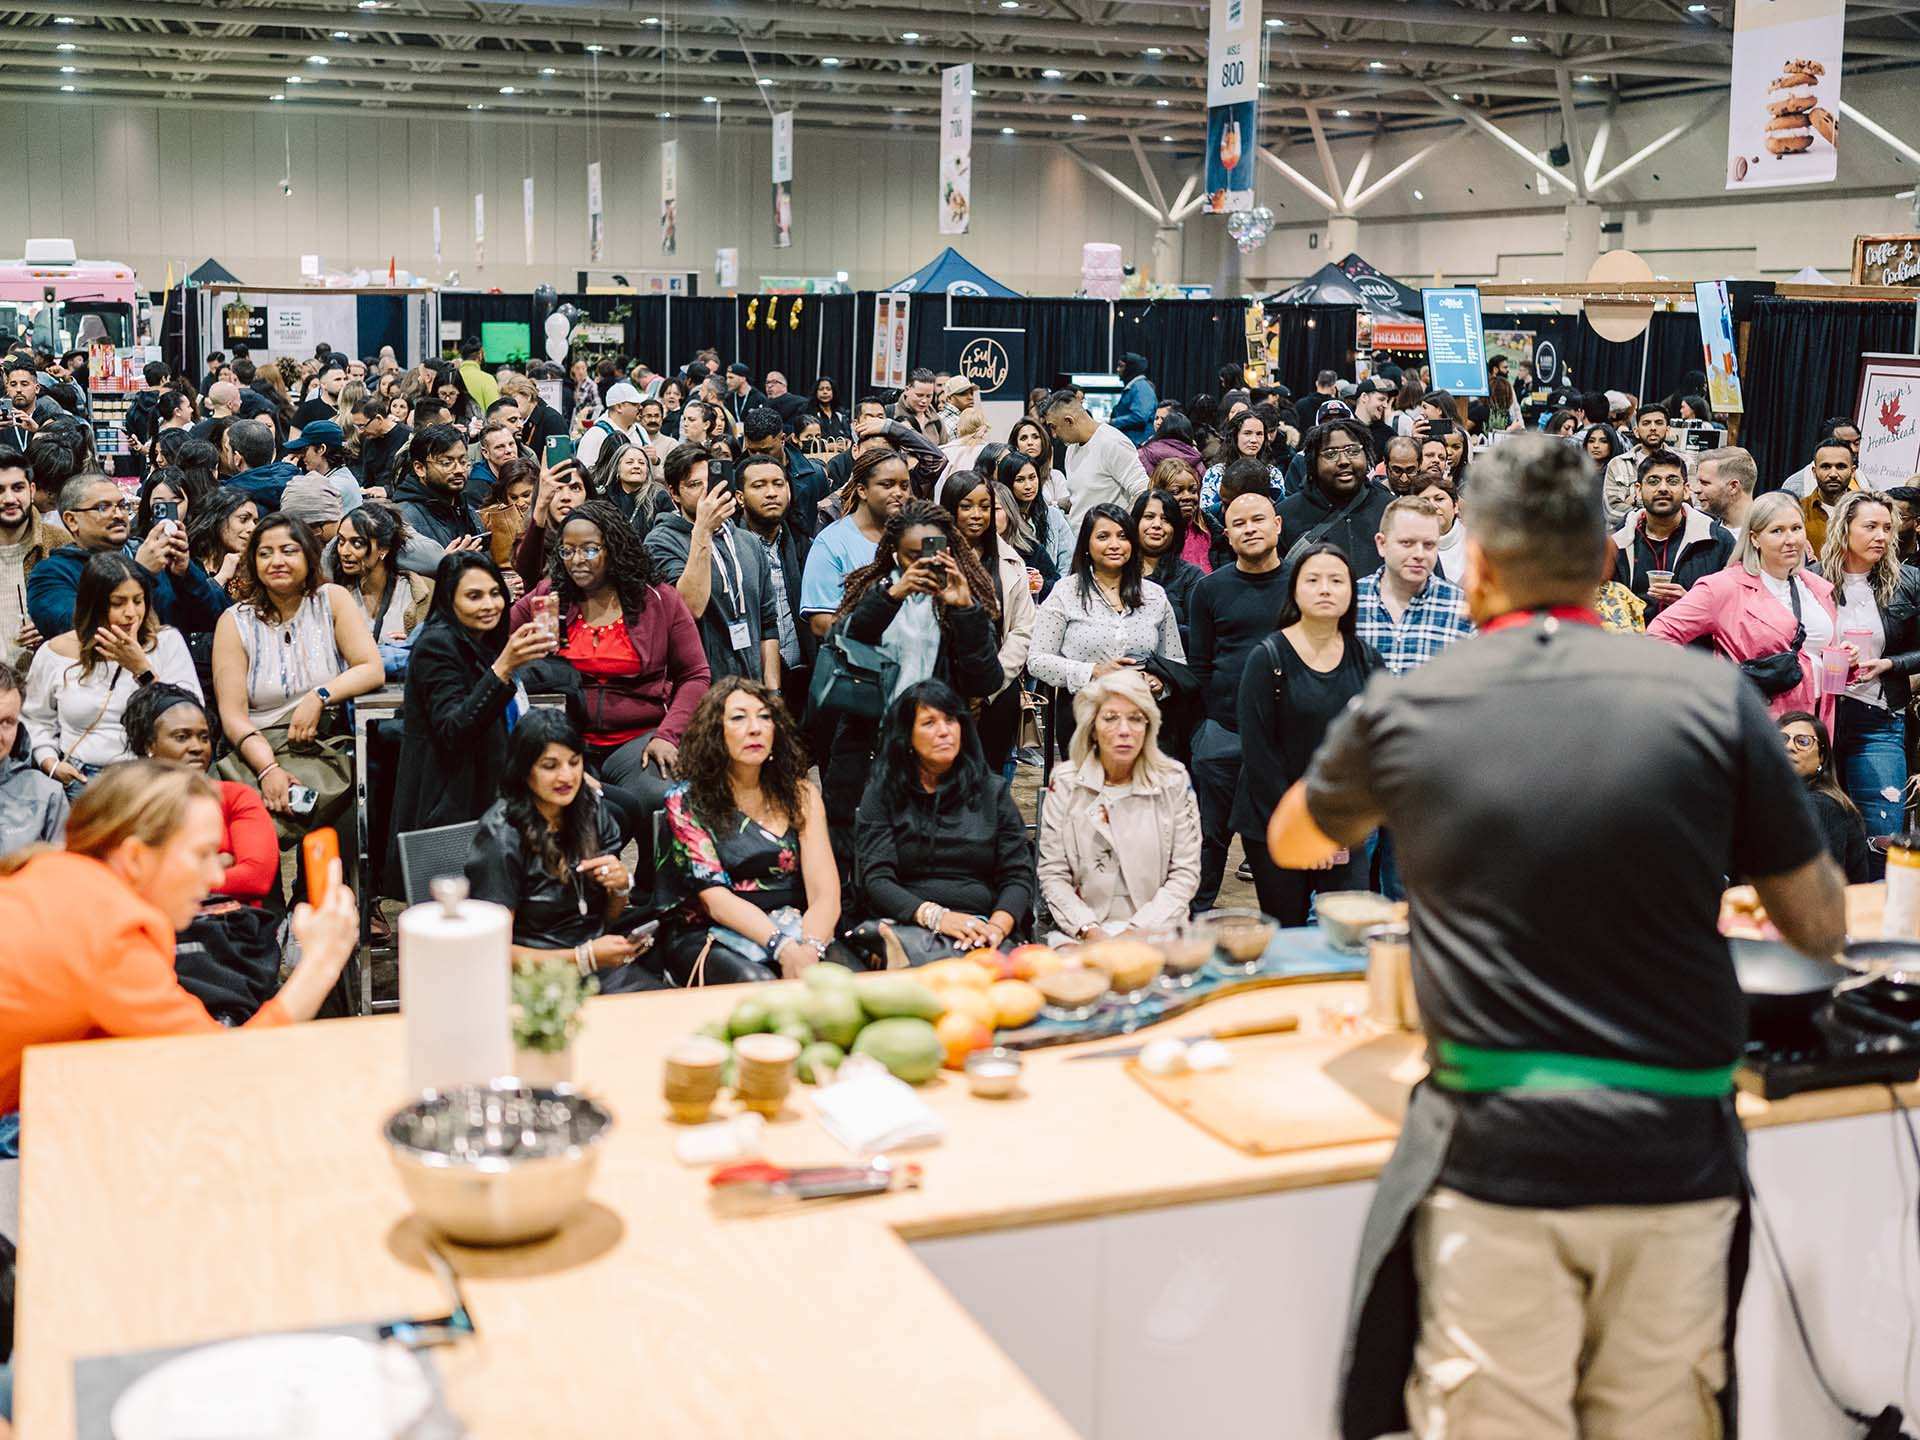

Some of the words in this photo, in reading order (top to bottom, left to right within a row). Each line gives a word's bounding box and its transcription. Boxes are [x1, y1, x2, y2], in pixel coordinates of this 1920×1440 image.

[1222, 61, 1244, 87] 800
[1866, 242, 1898, 266] Coffee
[1904, 242, 1913, 261] &
[1867, 419, 1916, 452] Homestead
